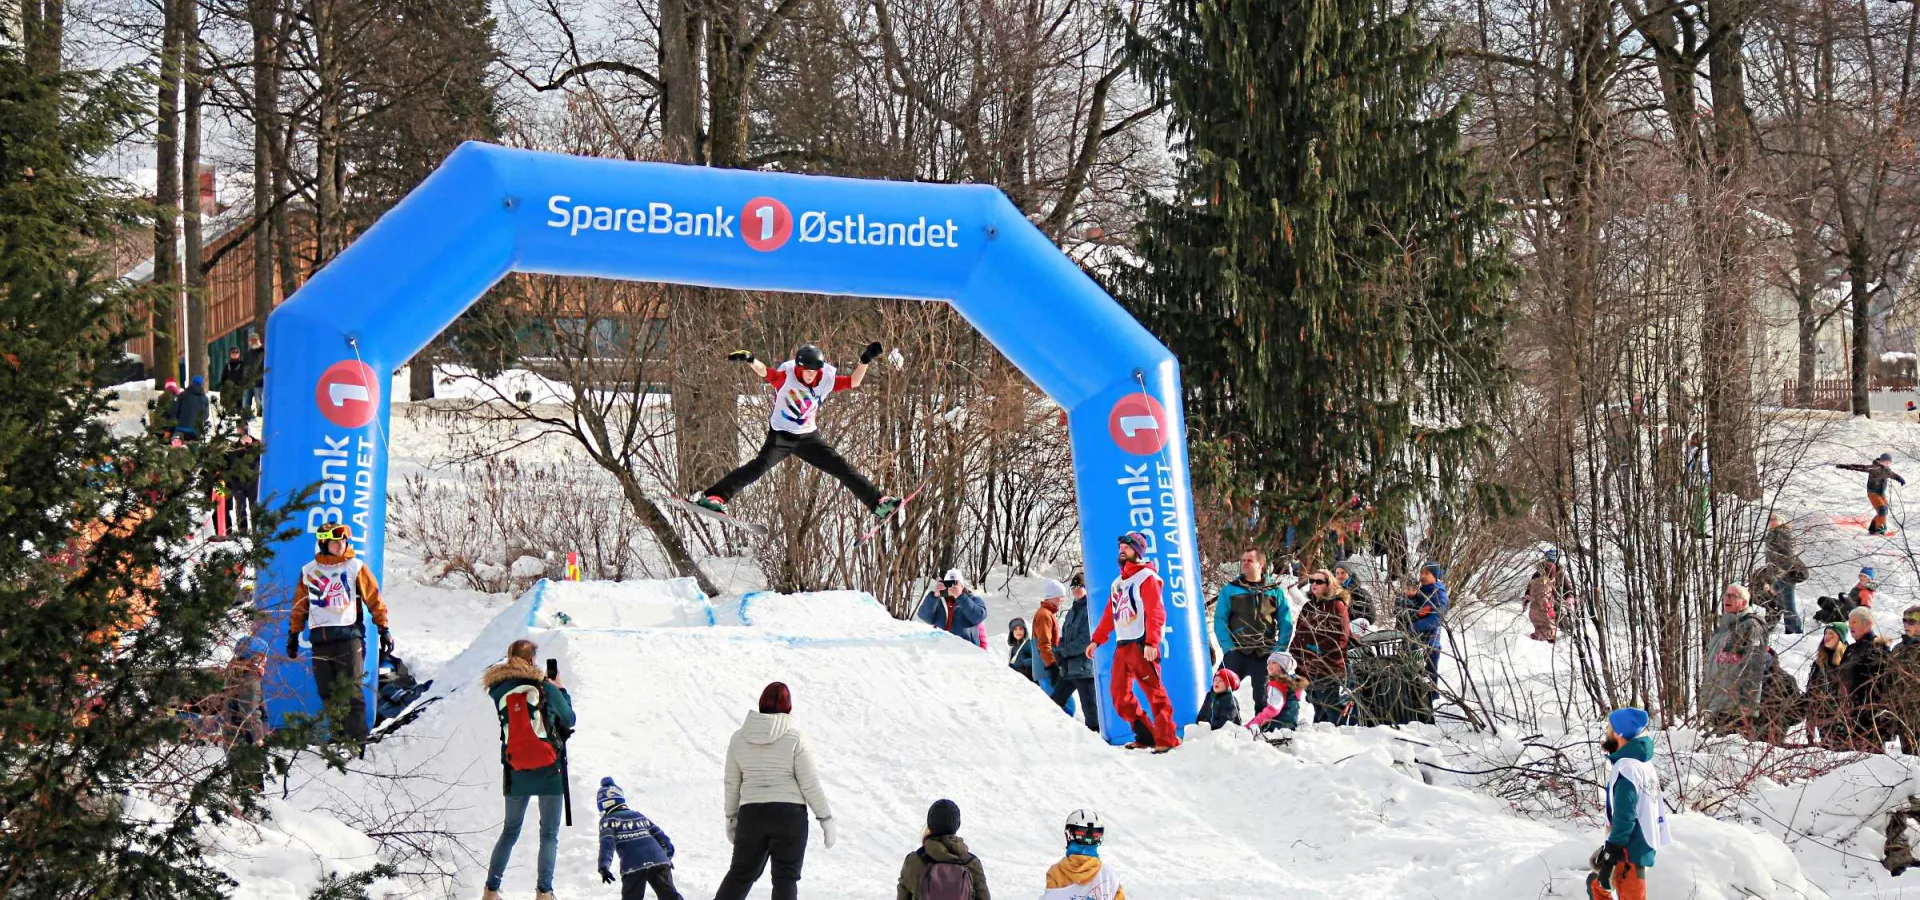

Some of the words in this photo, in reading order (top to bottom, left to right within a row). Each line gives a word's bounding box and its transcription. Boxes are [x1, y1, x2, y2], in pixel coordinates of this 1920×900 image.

[548, 195, 734, 238] SpareBank
[755, 205, 775, 241] 1
[799, 210, 958, 248] Østlandet
[1156, 461, 1188, 608] ØSTLANDET
